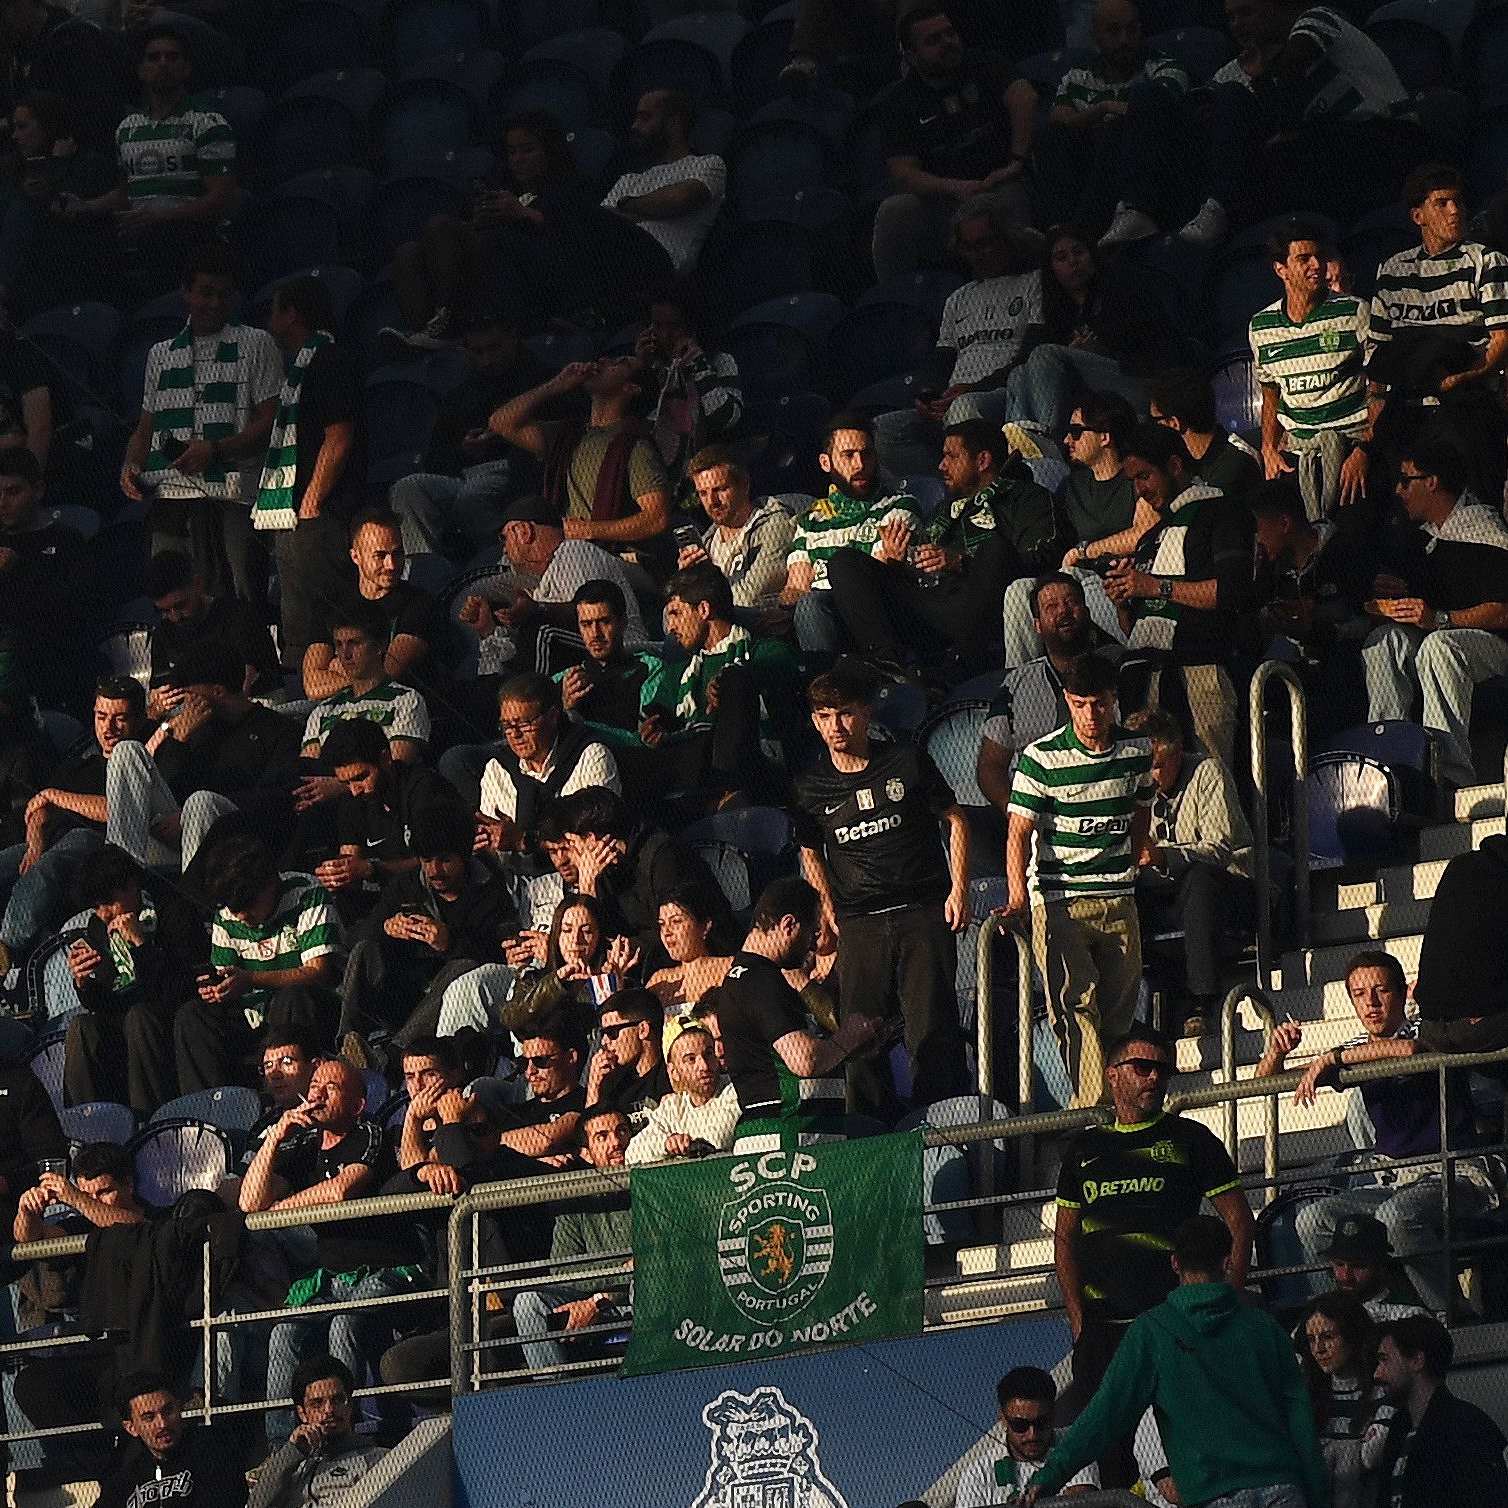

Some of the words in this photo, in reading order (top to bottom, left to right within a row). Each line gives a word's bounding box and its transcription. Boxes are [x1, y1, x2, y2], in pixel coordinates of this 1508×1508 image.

[834, 813, 902, 845] Betano
[729, 1150, 817, 1194] SCP
[1099, 1176, 1165, 1198] BETANO
[728, 1191, 821, 1234] SPORTING
[736, 1281, 819, 1312] PORTUGAL
[673, 1317, 747, 1353] SOLAR
[747, 1329, 784, 1352] DO
[790, 1291, 878, 1343] NORTE
